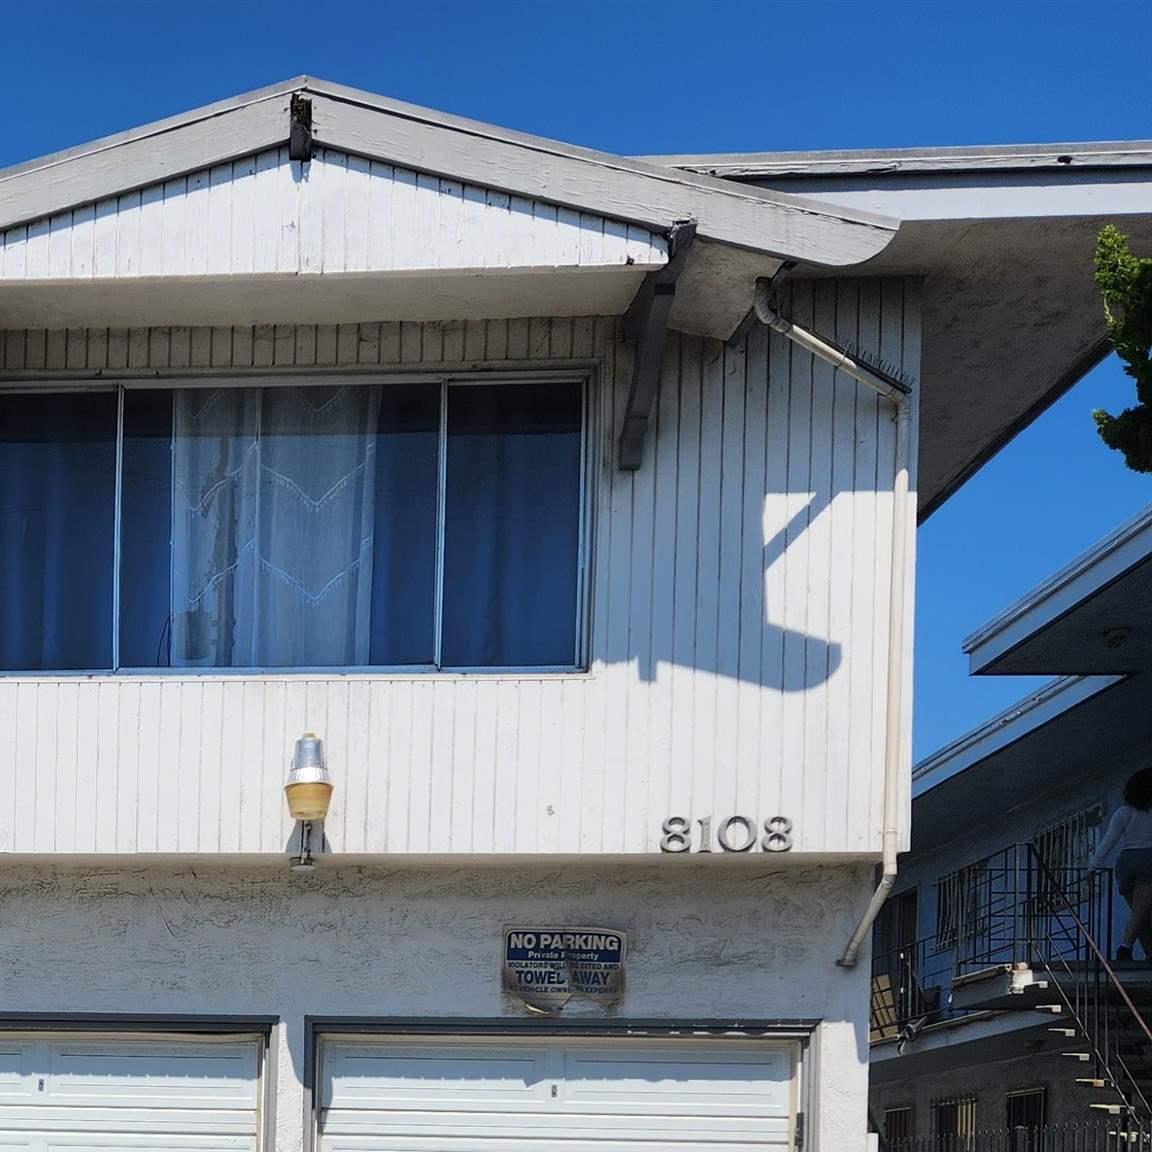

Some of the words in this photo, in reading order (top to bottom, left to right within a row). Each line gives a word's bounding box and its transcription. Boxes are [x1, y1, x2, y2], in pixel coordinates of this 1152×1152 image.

[660, 816, 794, 853] 8108
[510, 934, 537, 949] NO
[540, 934, 619, 951] PARKING
[528, 951, 559, 960] Private
[508, 961, 547, 969] VIOLATORS
[580, 962, 602, 970] CITED
[573, 970, 610, 985] AWAY
